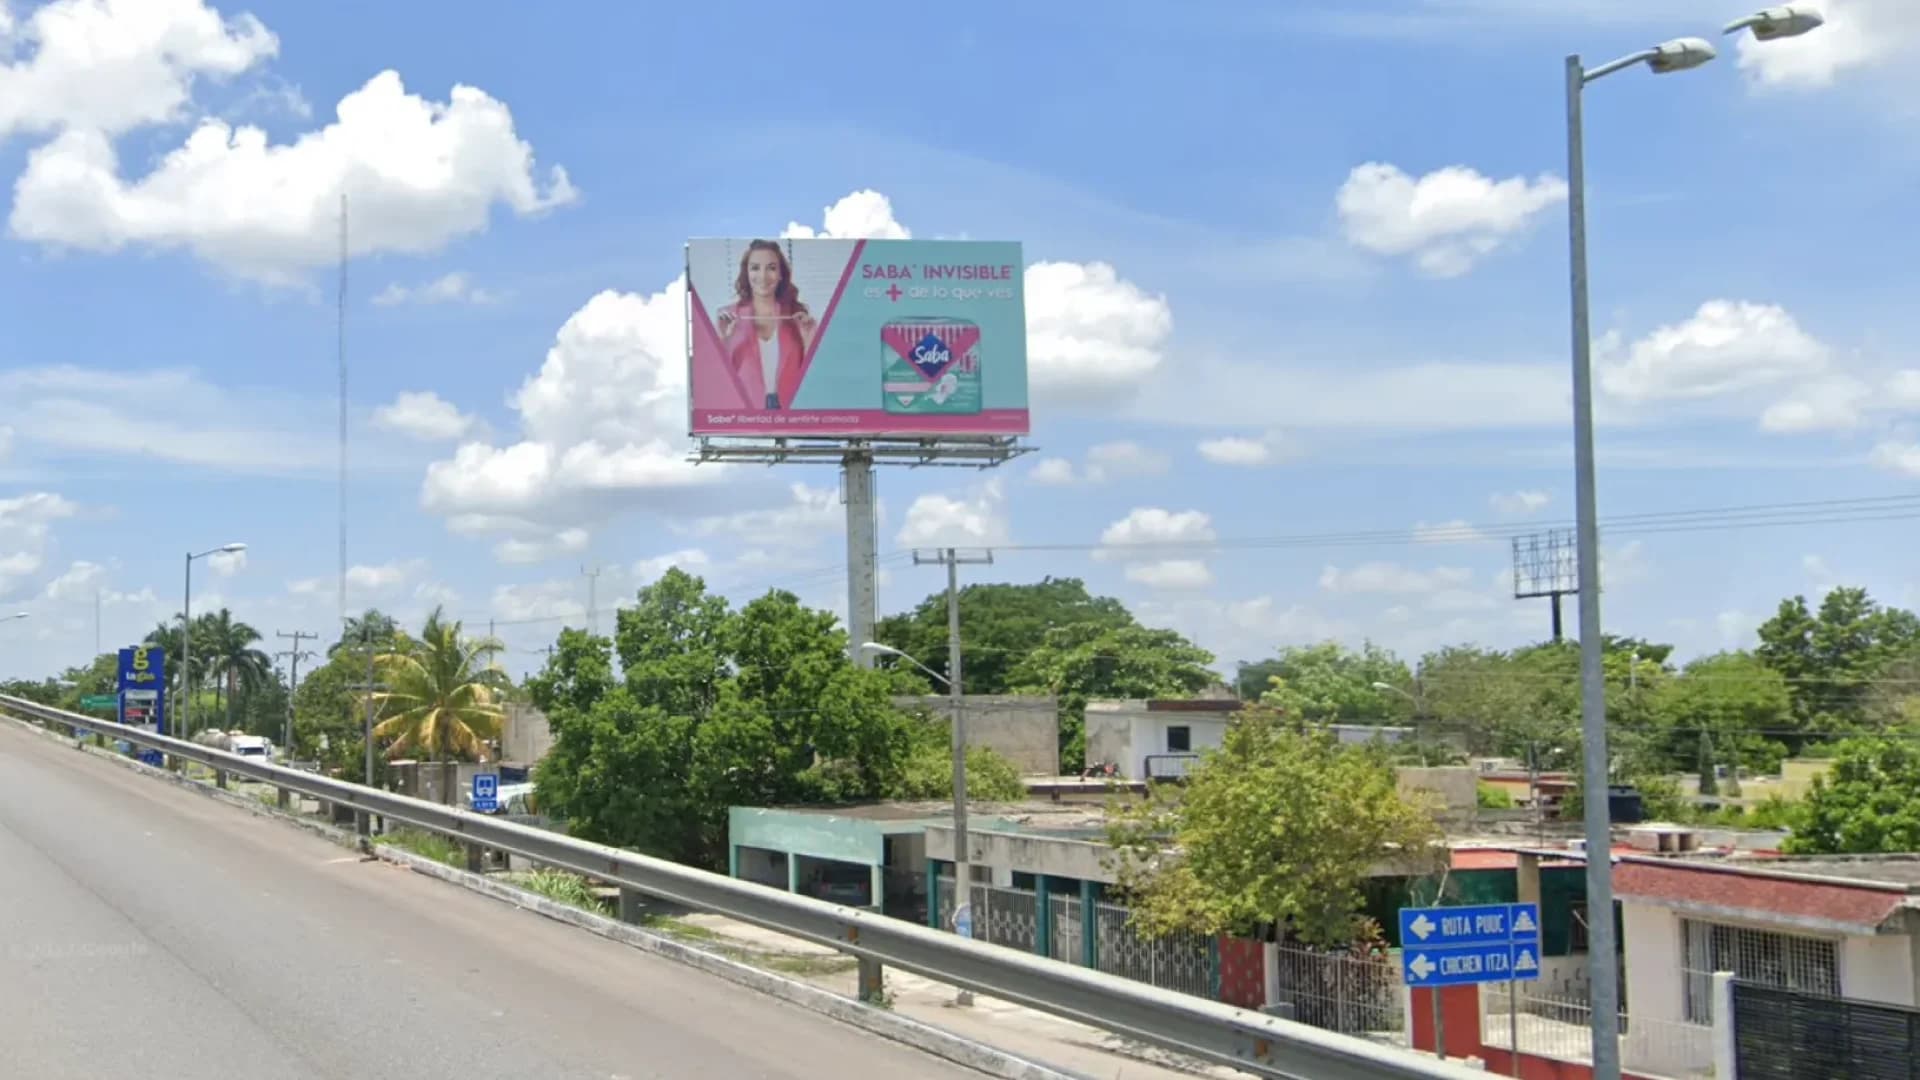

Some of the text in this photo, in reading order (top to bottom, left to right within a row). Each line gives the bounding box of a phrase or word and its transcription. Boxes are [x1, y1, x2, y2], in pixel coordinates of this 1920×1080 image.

[864, 287, 881, 299] es
[908, 285, 929, 299] de
[933, 285, 949, 299] lo
[952, 287, 983, 301] que
[987, 287, 1014, 299] ves
[914, 344, 950, 364] Saba
[1441, 914, 1505, 937] RUTA PUUC
[1440, 953, 1510, 976] CHICHEN ITZA
